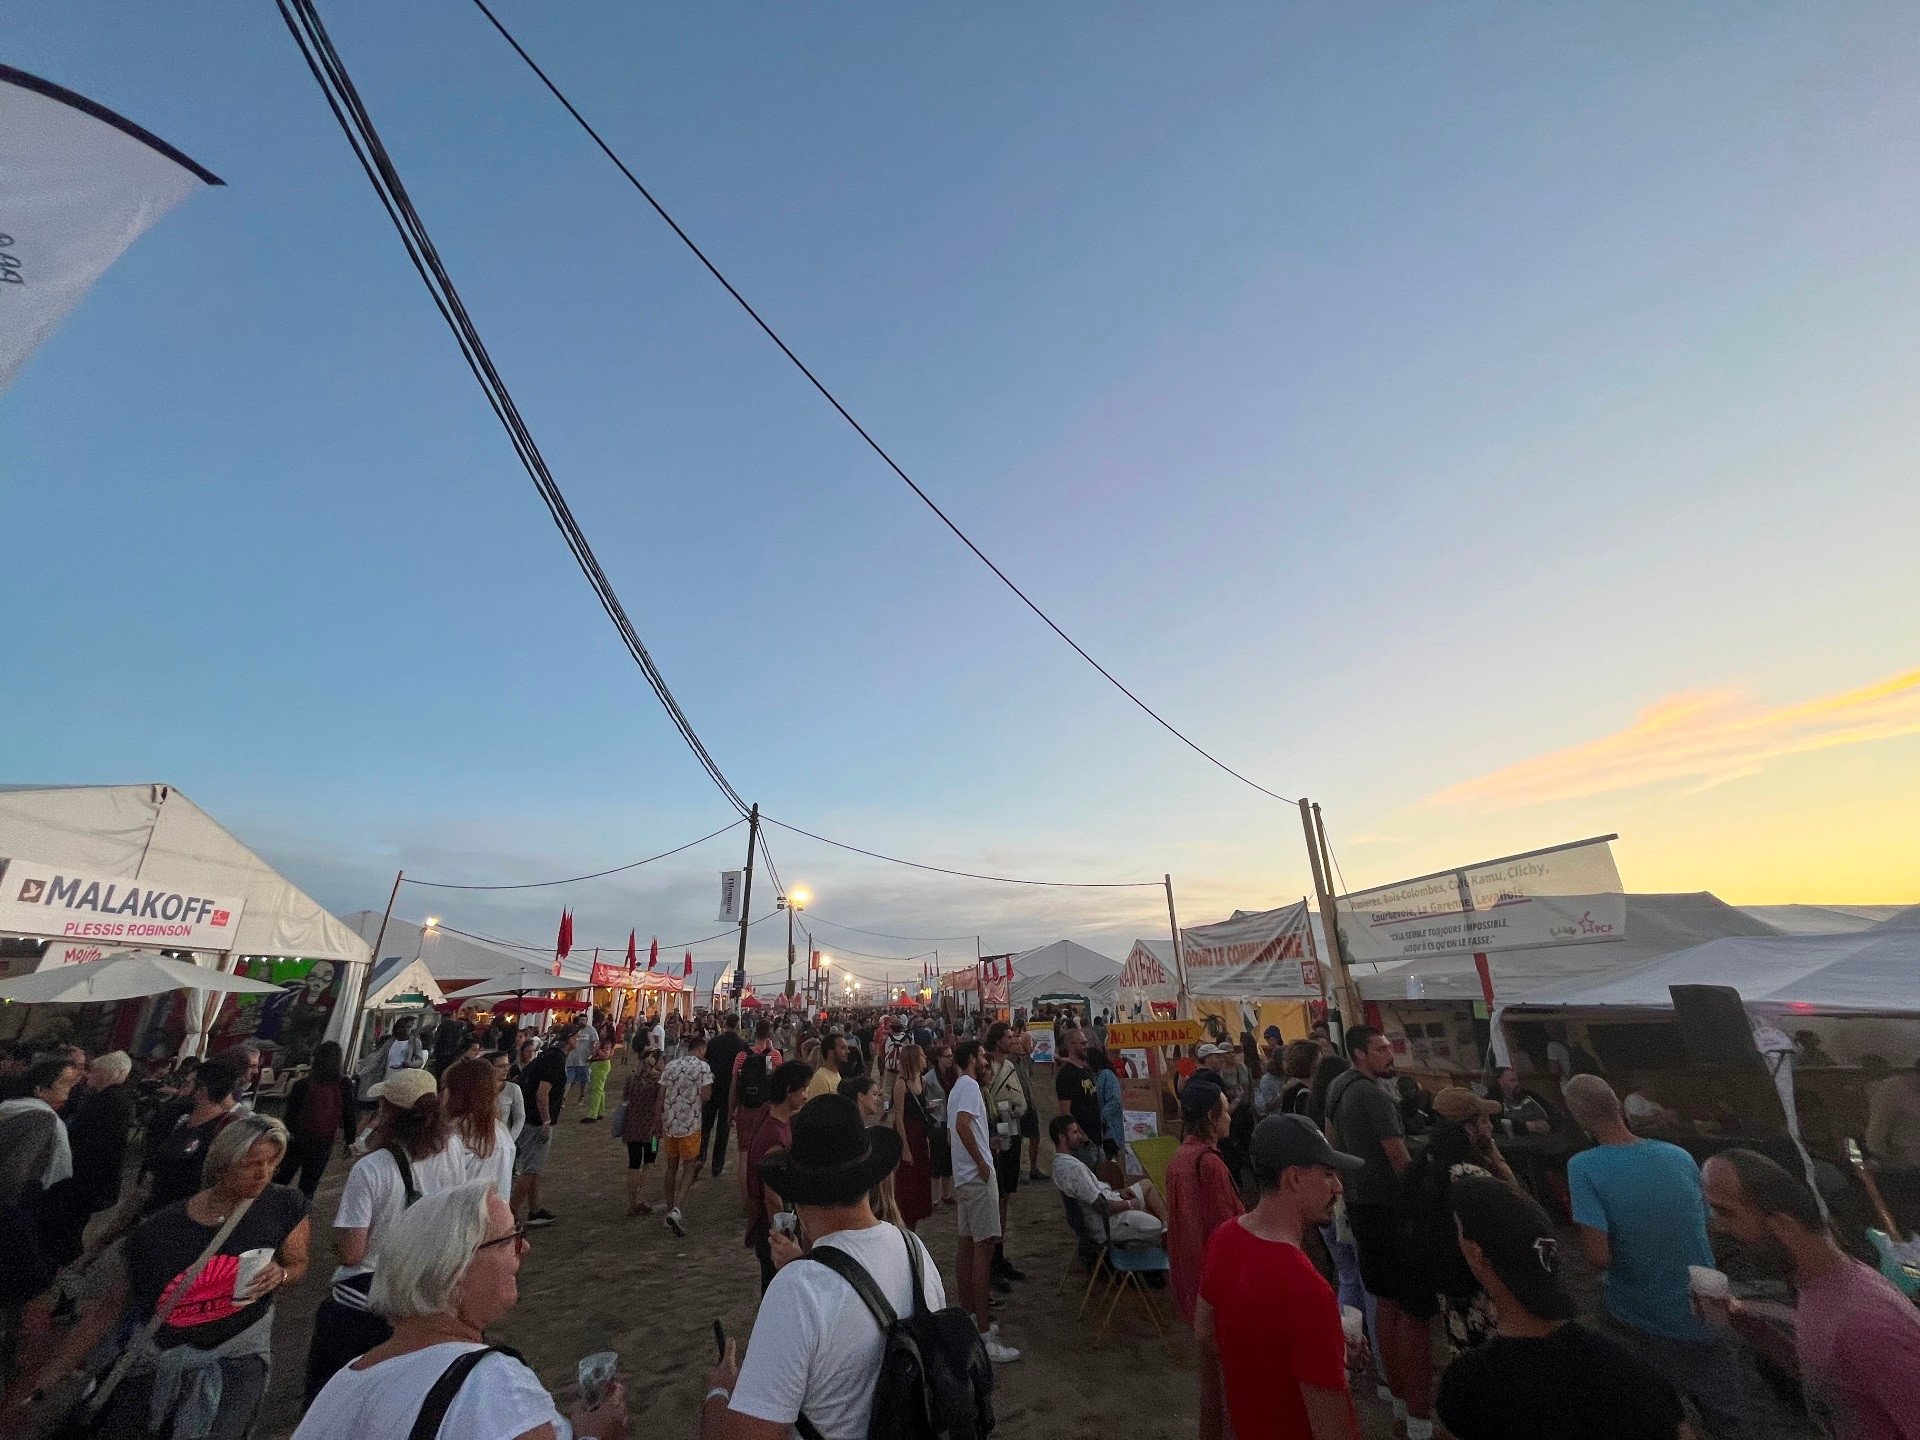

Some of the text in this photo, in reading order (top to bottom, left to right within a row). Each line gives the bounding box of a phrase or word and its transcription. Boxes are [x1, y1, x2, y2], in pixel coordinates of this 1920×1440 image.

[1383, 886, 1447, 903] Bois-Colombes,
[1471, 871, 1507, 886] Kamu,
[1507, 862, 1549, 879] Clichy,
[44, 875, 216, 924] MALAKOFF
[1418, 905, 1429, 915] La
[1475, 887, 1523, 905] Levallois
[63, 922, 192, 937] PLESSIS ROBINSON
[1427, 924, 1462, 938] TOUJOURS
[1594, 924, 1614, 934] PCF
[1458, 938, 1467, 947] LE
[1213, 946, 1225, 966] LE
